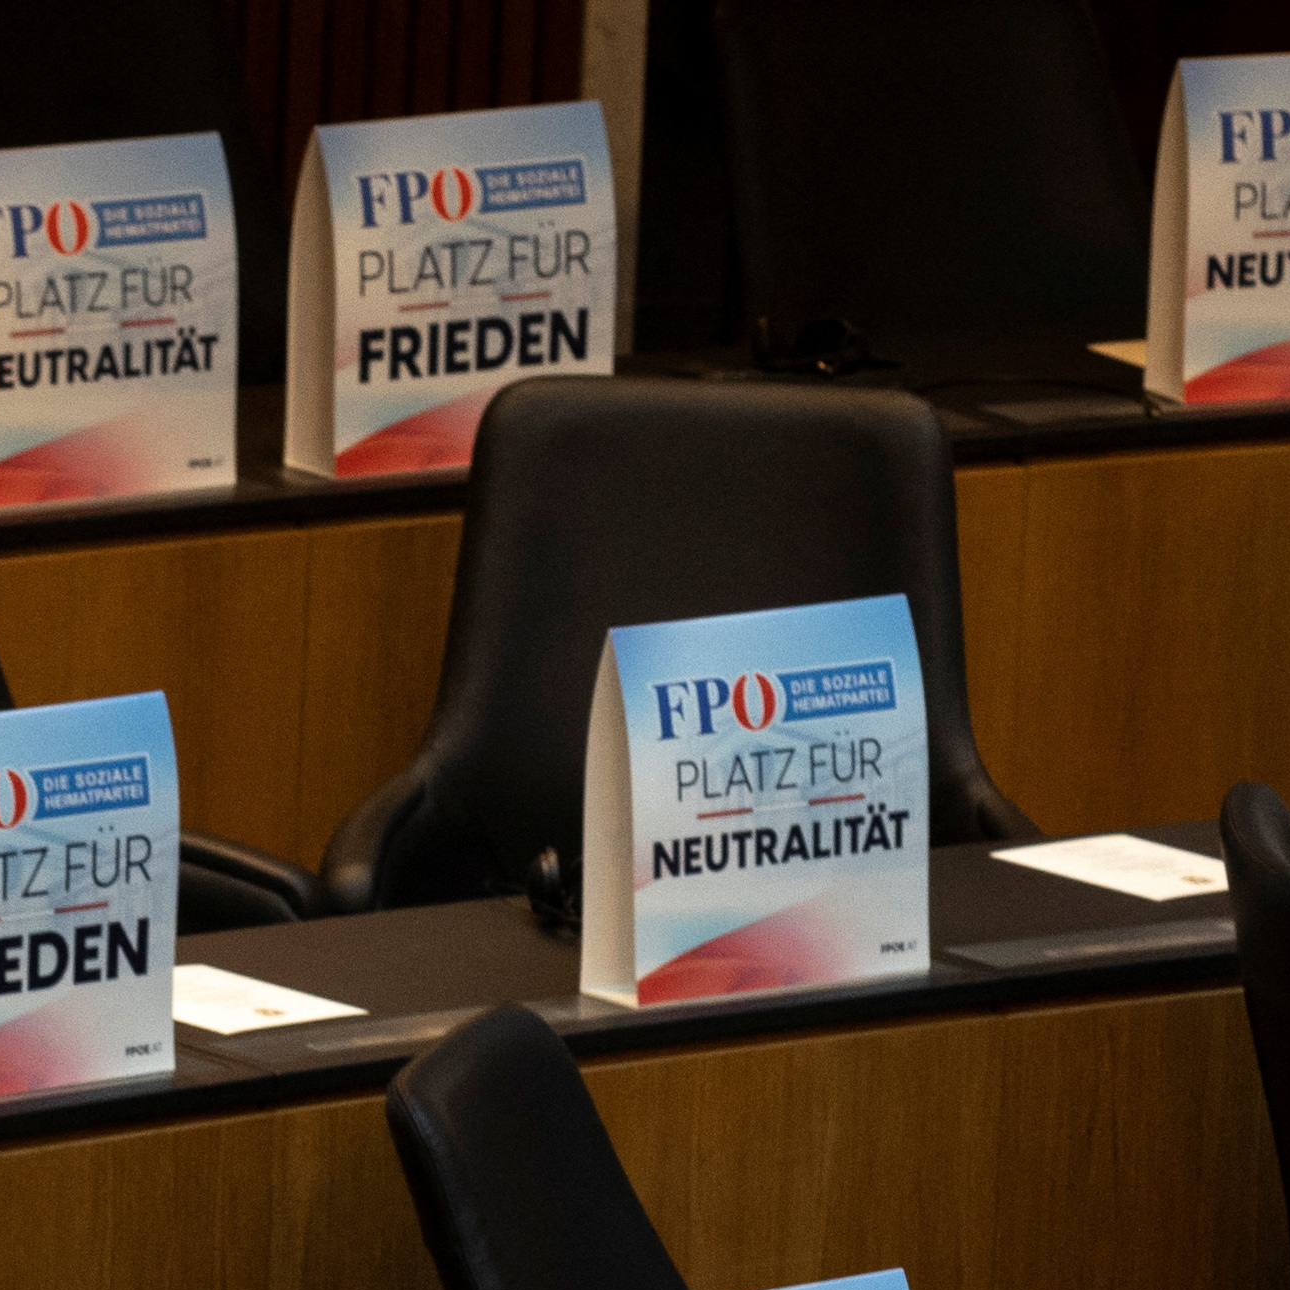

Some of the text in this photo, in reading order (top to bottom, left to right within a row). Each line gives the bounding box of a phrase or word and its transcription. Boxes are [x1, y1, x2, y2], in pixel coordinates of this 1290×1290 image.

[122, 257, 193, 309] FÜR
[360, 221, 590, 296] PLATZ FÜR
[359, 307, 588, 383] FRIEDEN
[676, 730, 882, 802] PLATZ FÜR
[66, 825, 152, 892] FÜR
[653, 803, 909, 880] NEUTRALITÄT
